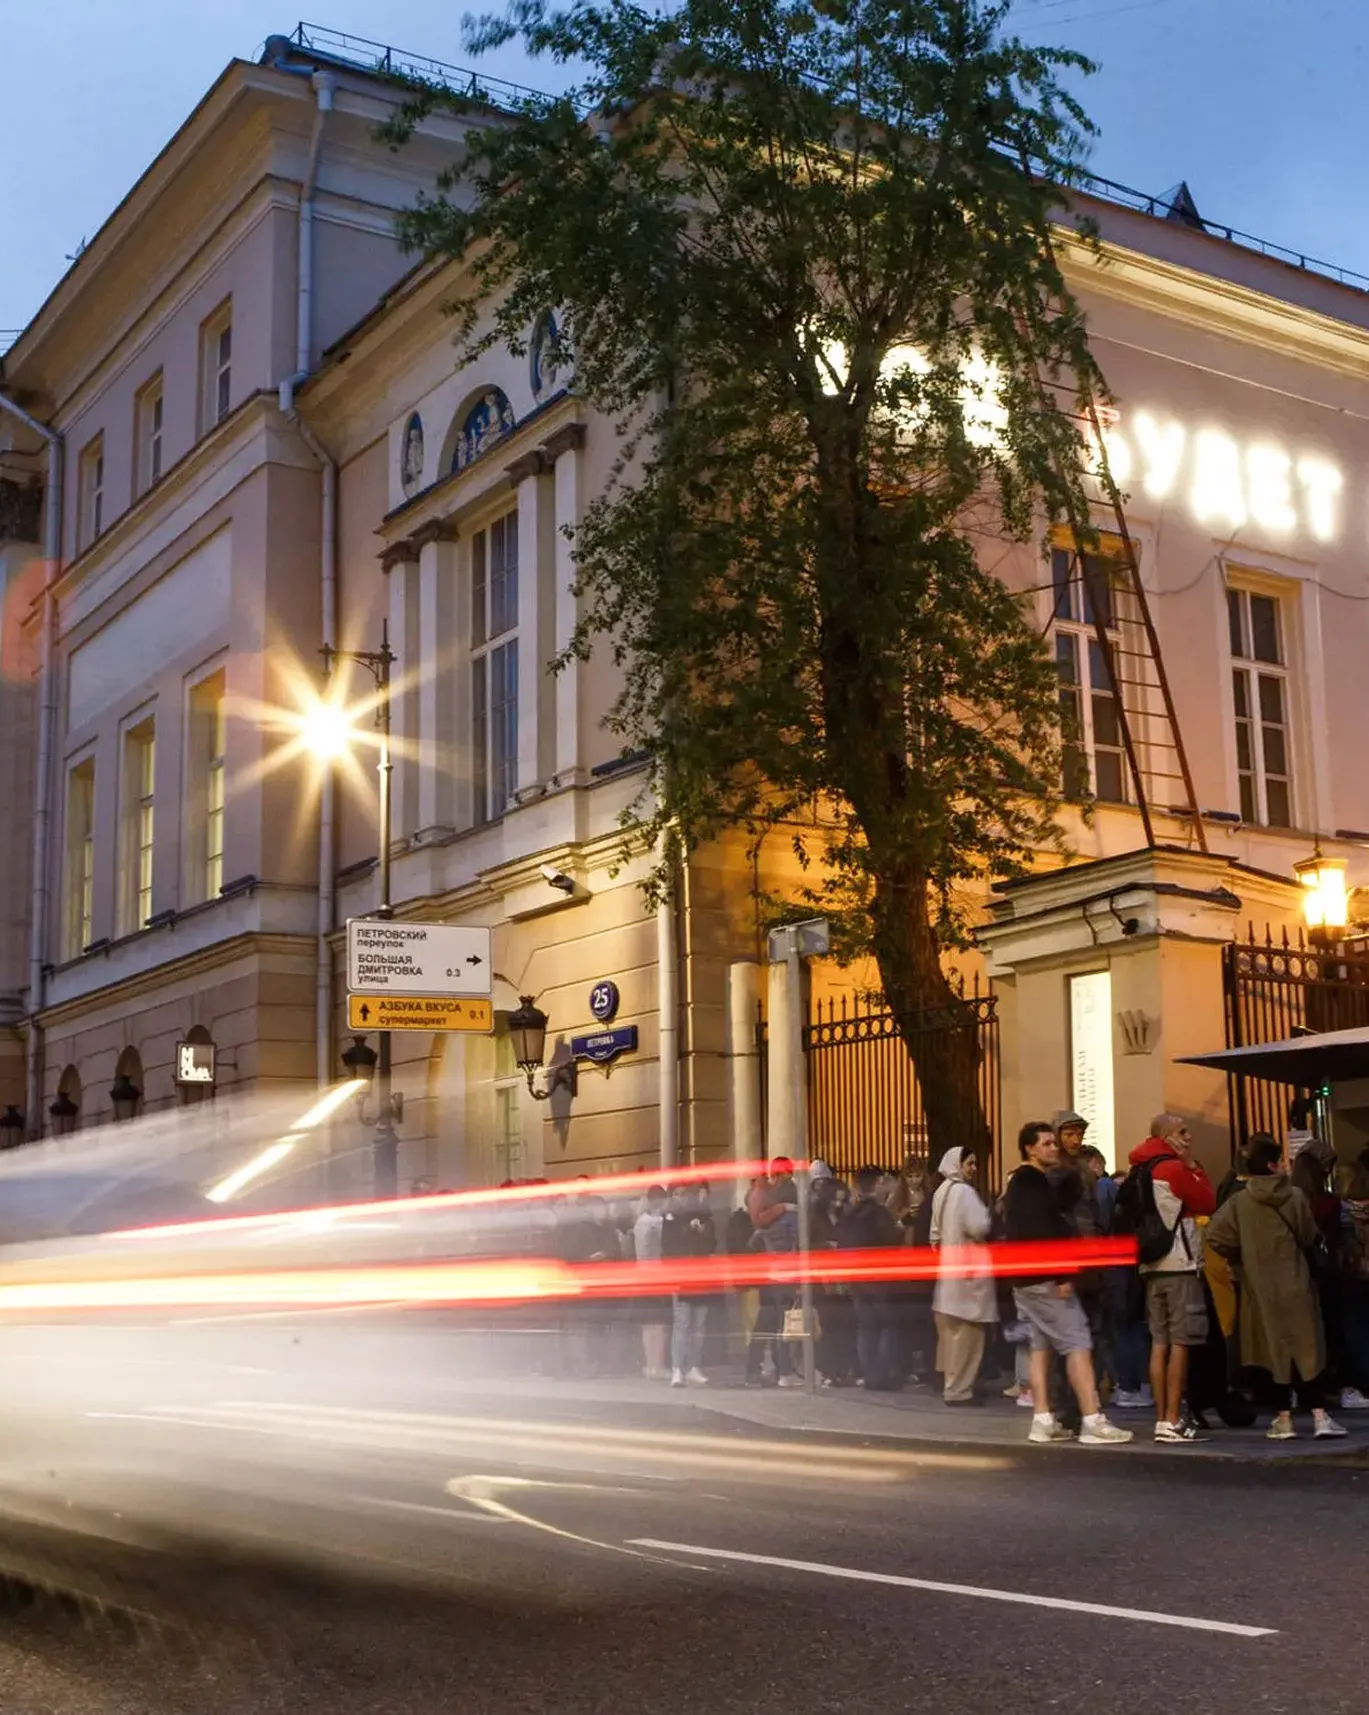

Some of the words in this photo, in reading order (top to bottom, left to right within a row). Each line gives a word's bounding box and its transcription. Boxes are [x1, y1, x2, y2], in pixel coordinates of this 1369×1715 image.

[1084, 405, 1343, 539] БУДЕТ
[357, 929, 427, 940] ПЕТРОВСКИЙ
[357, 939, 404, 949] переулок
[358, 954, 412, 964] БОЛЬШАЯ
[358, 965, 423, 975] ДМИТРОВКА
[446, 968, 461, 977] 0.3
[358, 975, 389, 984] улица
[594, 987, 608, 1009] 25
[379, 1001, 422, 1011] АЗБУКА
[425, 1003, 462, 1012] ВКУСА
[469, 1010, 484, 1019] 0.1
[379, 1015, 447, 1026] супермаркет
